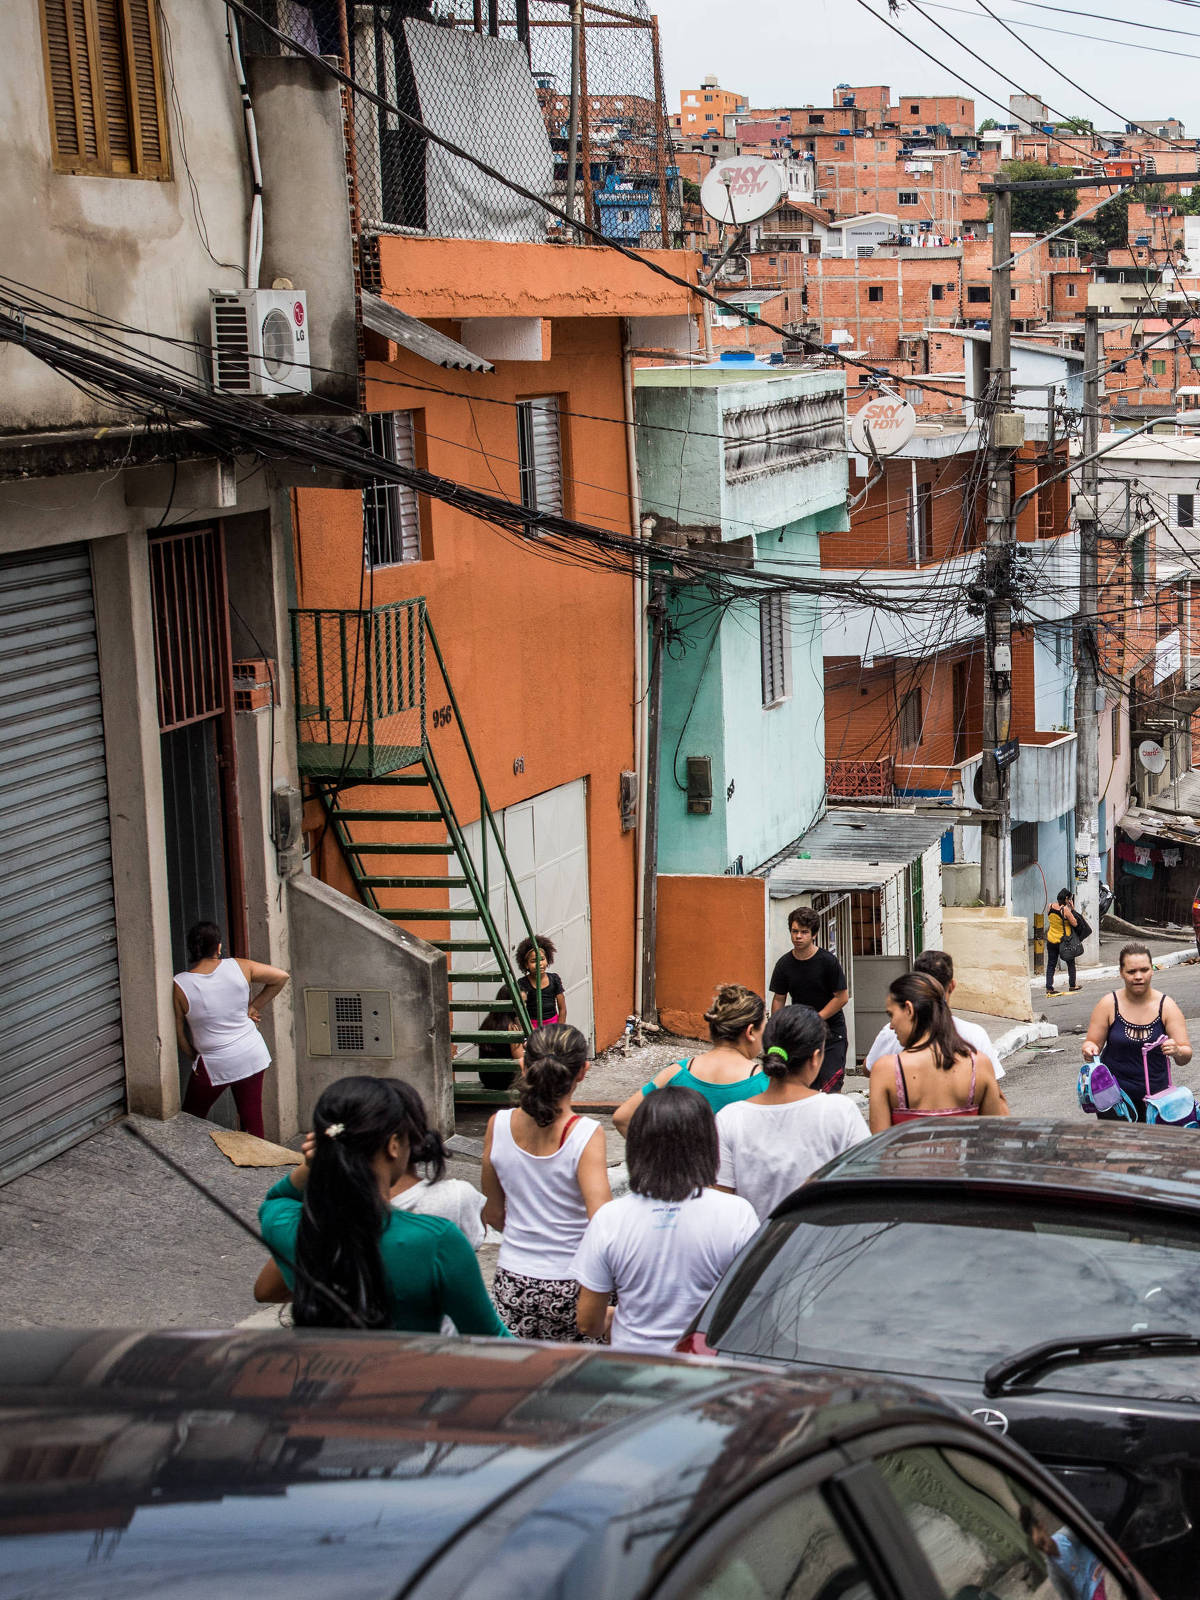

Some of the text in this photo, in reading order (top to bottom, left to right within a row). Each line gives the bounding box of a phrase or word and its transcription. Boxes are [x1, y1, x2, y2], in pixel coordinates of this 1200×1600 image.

[717, 164, 767, 185] SKY
[730, 181, 768, 195] HDTV
[295, 329, 305, 342] LG
[864, 404, 902, 419] SKY
[872, 418, 904, 430] HDTV
[432, 705, 452, 728] 956
